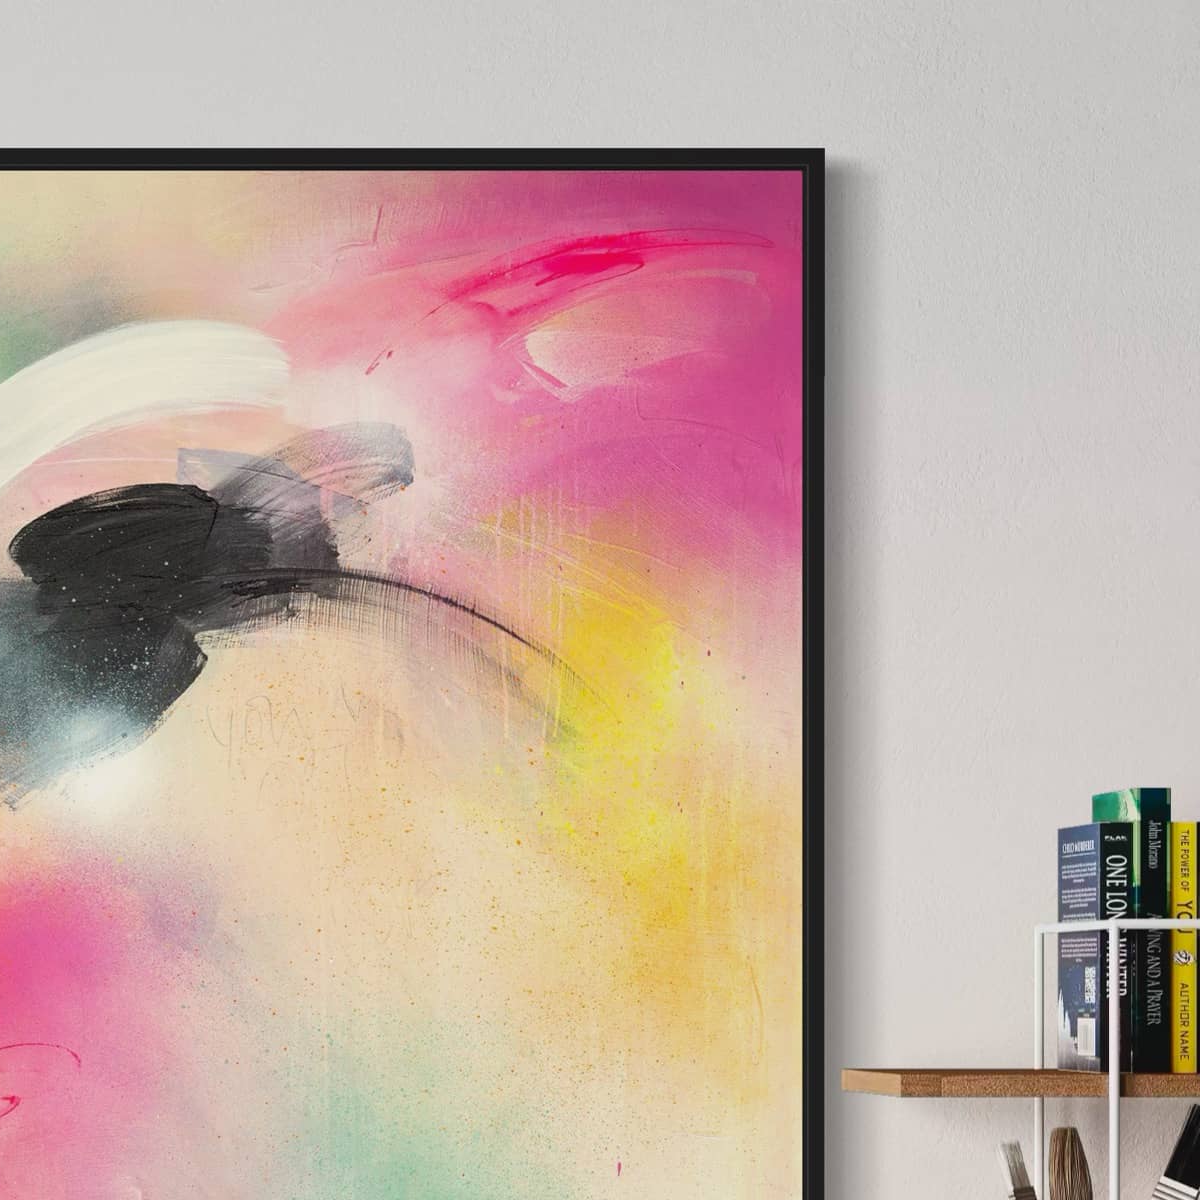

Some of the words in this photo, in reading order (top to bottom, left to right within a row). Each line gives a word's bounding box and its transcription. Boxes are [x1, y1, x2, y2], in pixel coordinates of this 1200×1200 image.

[1148, 820, 1163, 839] John
[1180, 829, 1189, 846] THE
[1106, 855, 1127, 887] ONE
[1180, 849, 1189, 878] POWER
[1180, 881, 1189, 892] OF
[1106, 892, 1127, 933] LON
[1180, 982, 1190, 1028] AUTHOR
[1180, 1030, 1190, 1061] NAME
